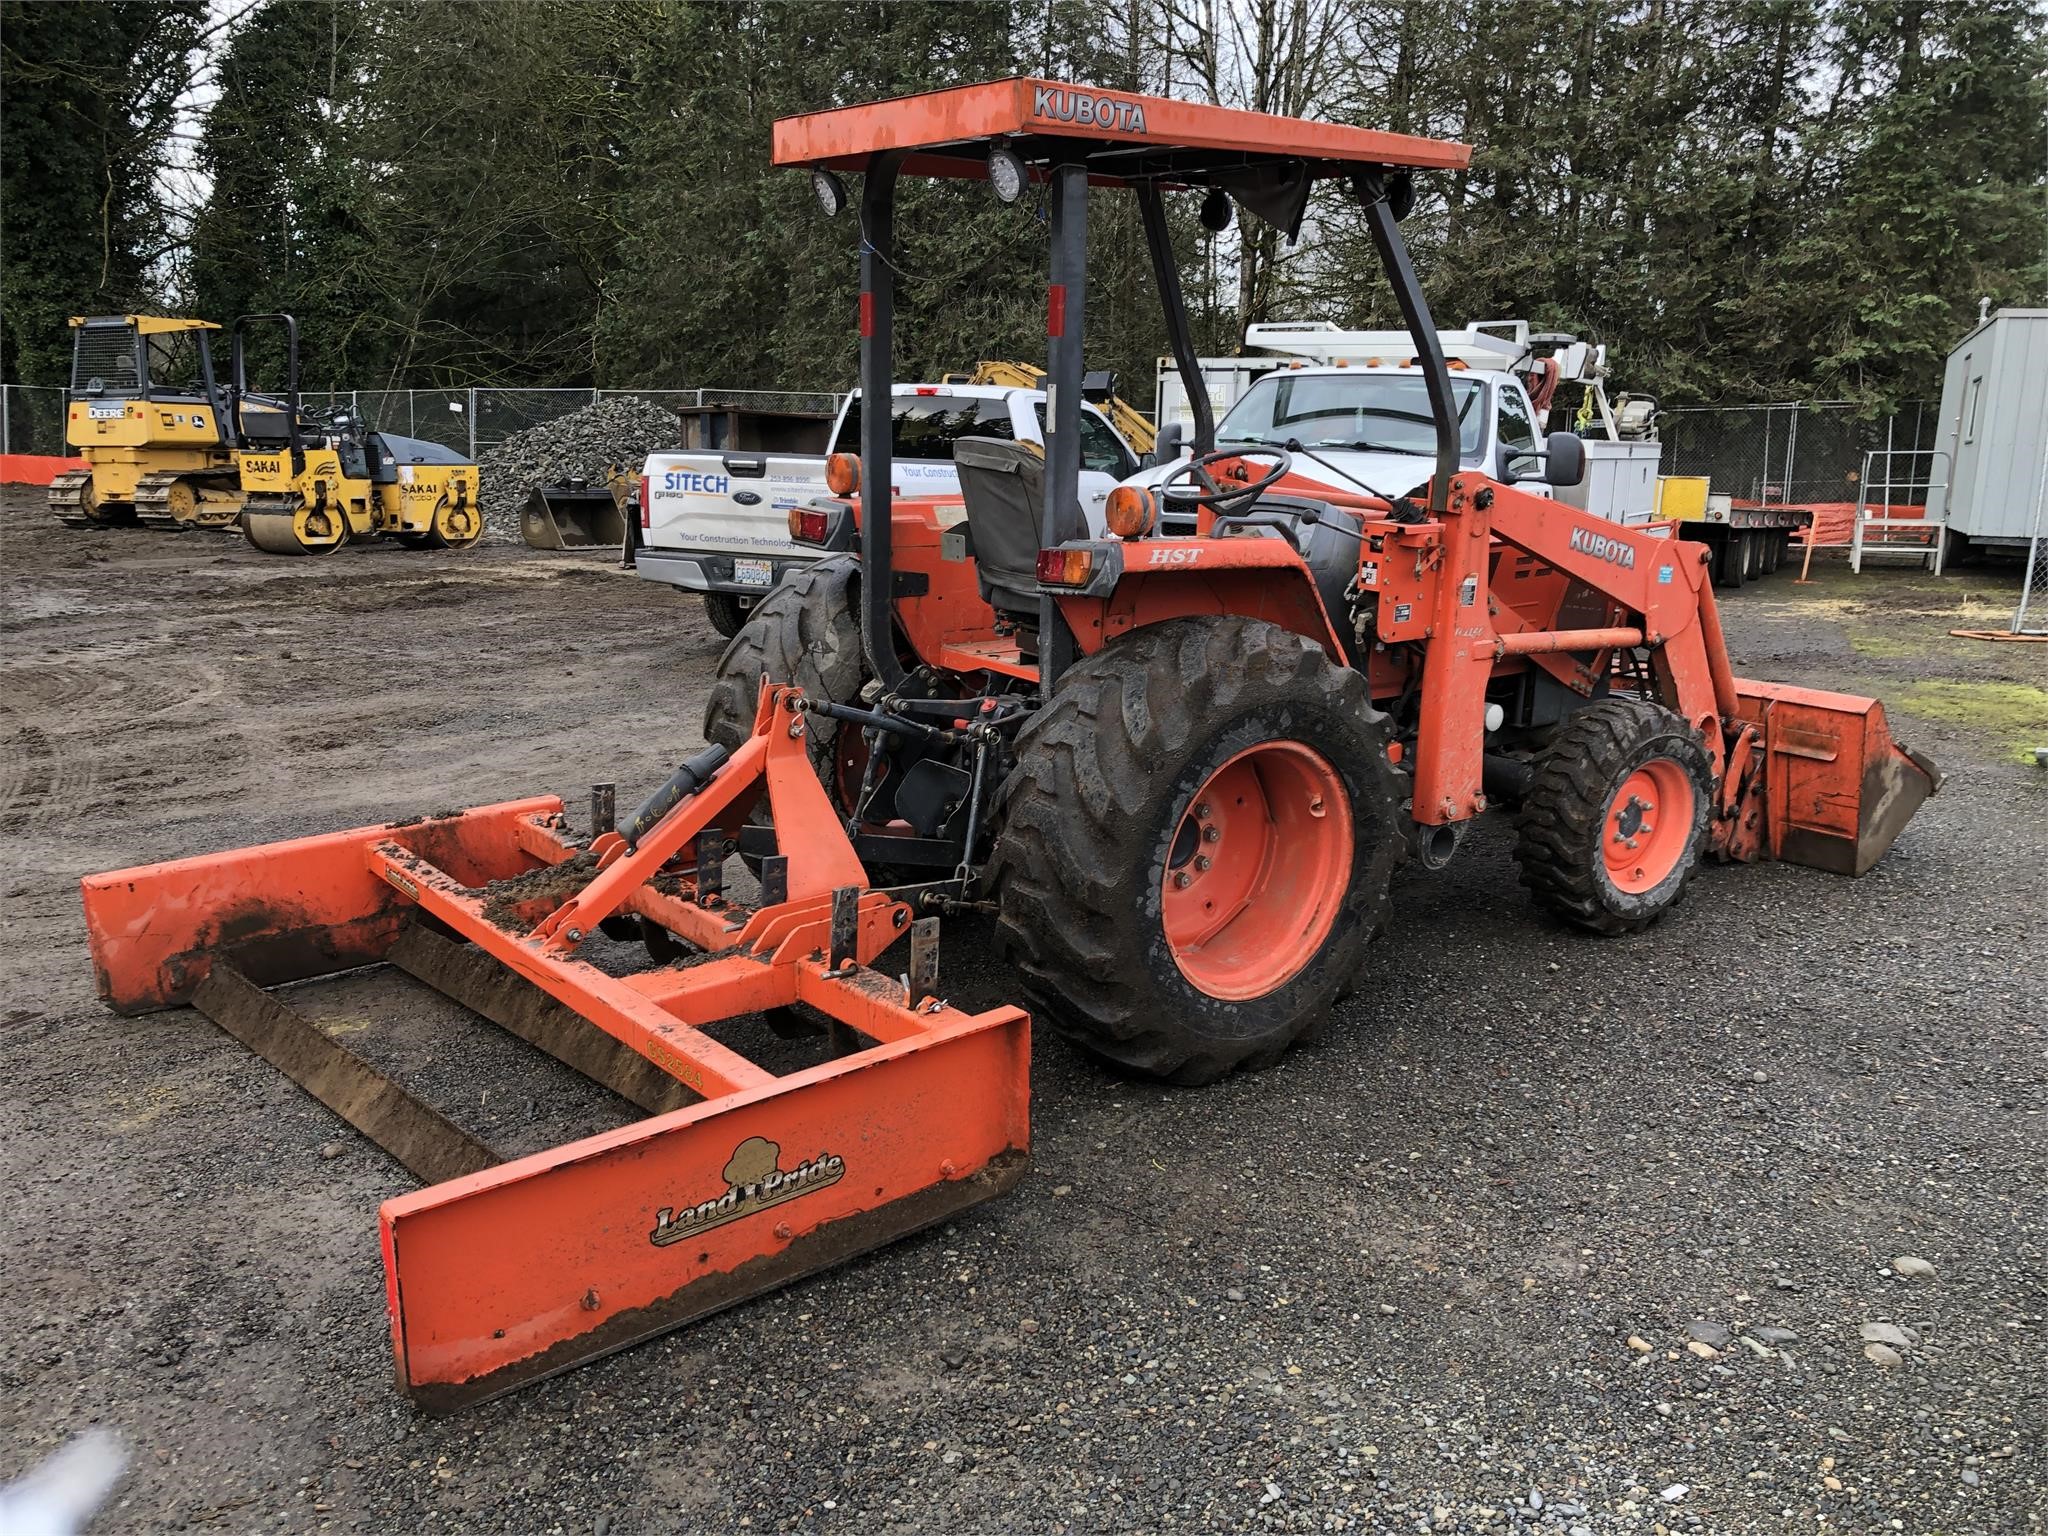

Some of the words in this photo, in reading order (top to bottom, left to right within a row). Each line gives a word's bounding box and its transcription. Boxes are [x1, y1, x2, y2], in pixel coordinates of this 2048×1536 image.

[1034, 84, 1147, 134] KUBOTA
[88, 407, 126, 419] DEERE
[246, 460, 281, 473] SAKAI
[902, 466, 921, 477] Your
[401, 484, 437, 494] SAKAI
[665, 472, 729, 494] SITECH
[680, 532, 698, 542] Your
[699, 533, 749, 545] Construction
[1569, 525, 1635, 569] KUBOTA
[1148, 548, 1204, 564] HST
[655, 1185, 739, 1238] Land
[762, 1153, 843, 1200] Pride
